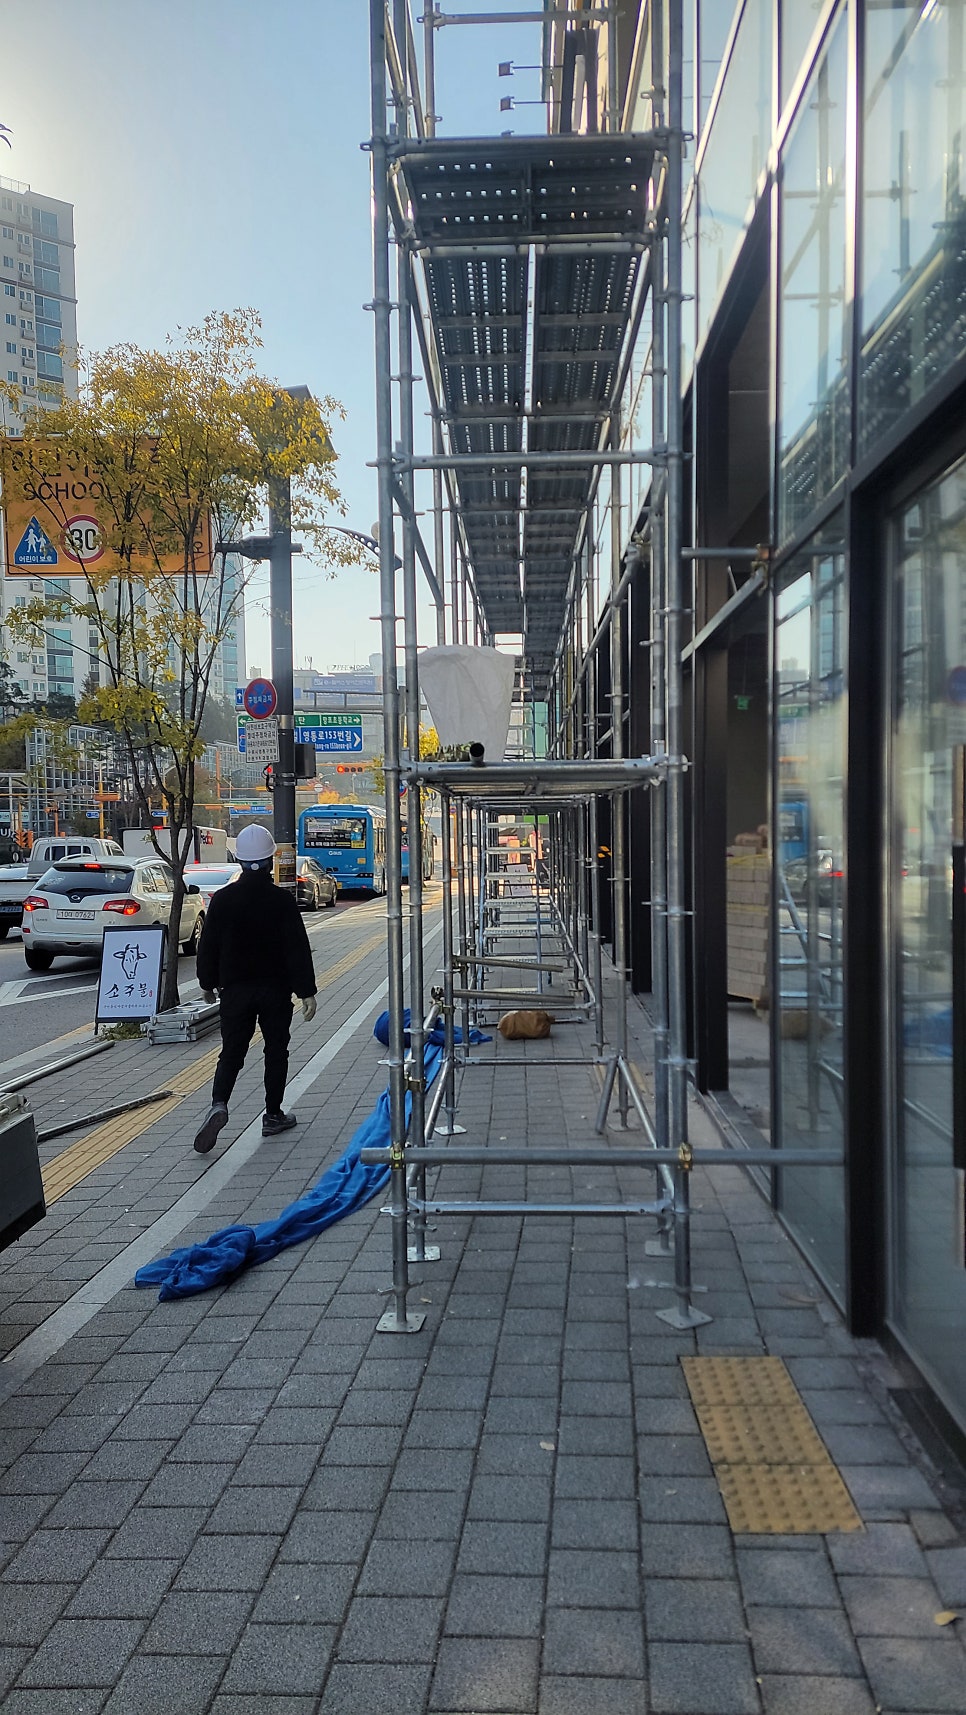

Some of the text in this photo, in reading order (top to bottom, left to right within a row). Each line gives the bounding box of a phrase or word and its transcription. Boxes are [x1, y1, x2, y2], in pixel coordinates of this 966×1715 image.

[23, 481, 117, 500] SCHOO
[70, 529, 98, 550] 30
[303, 730, 352, 742] 영통로153번길
